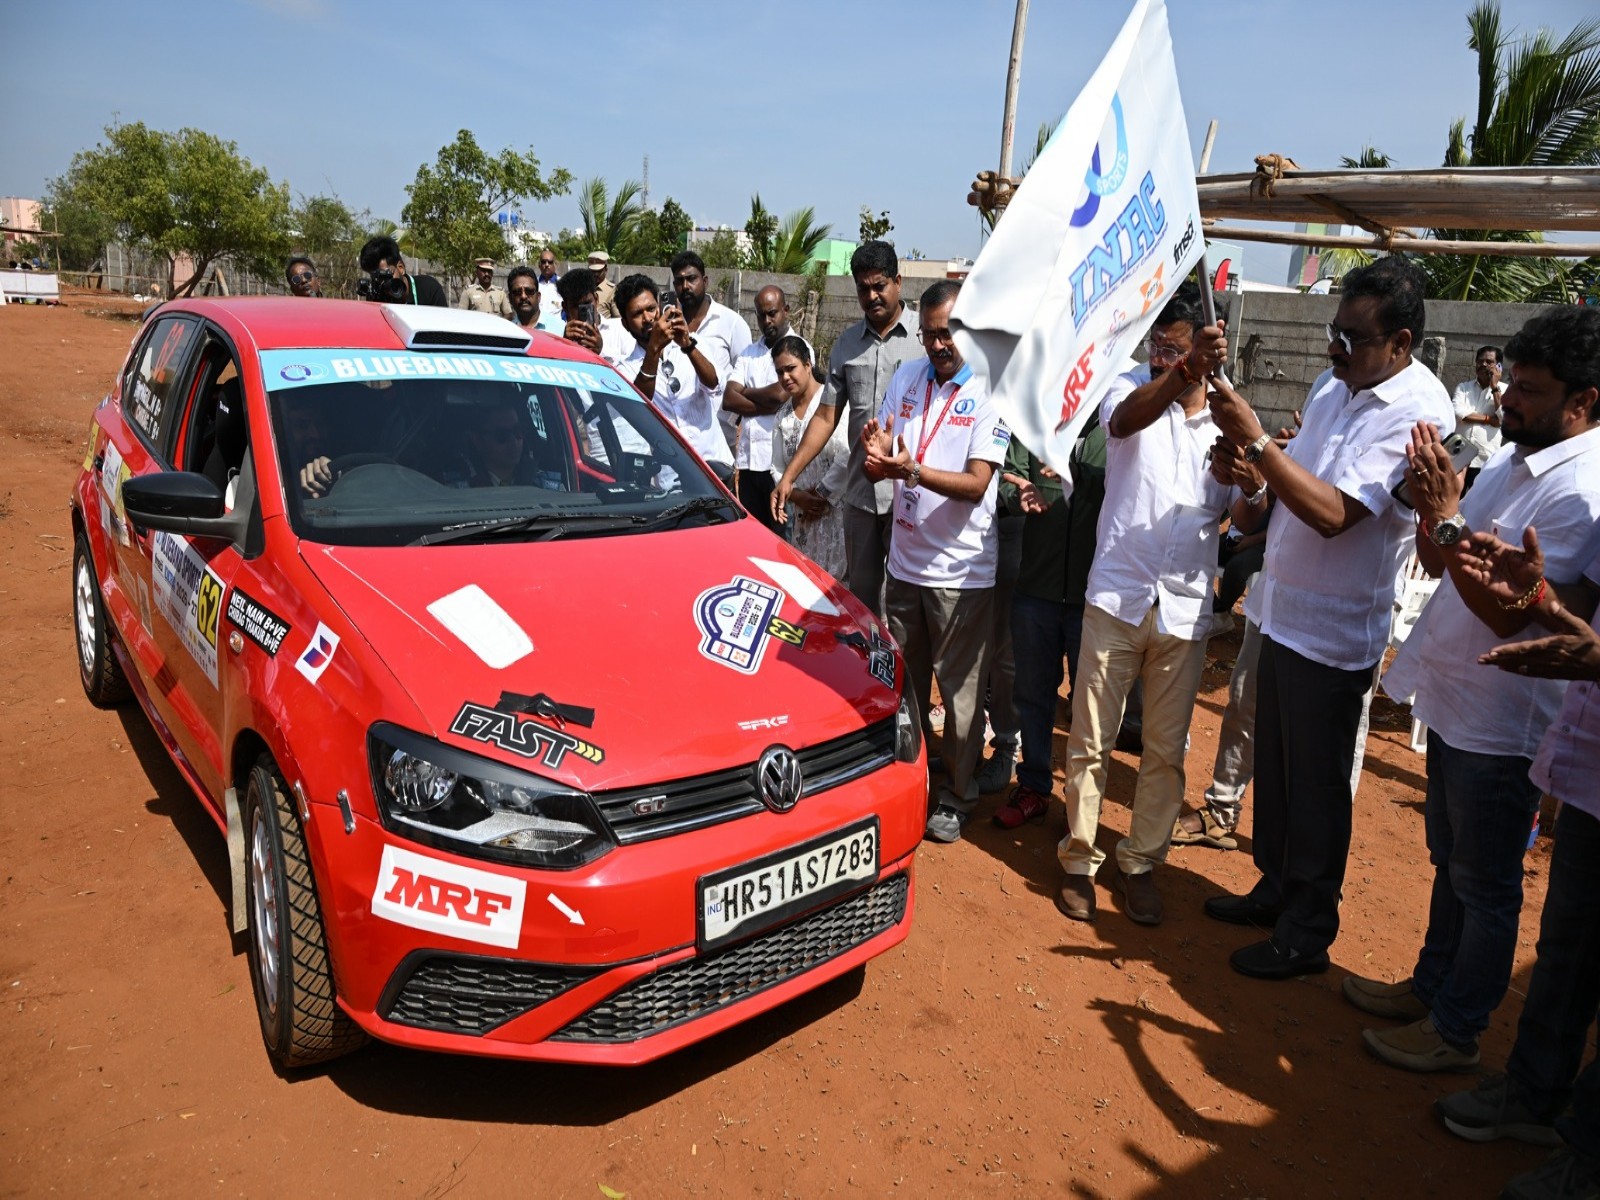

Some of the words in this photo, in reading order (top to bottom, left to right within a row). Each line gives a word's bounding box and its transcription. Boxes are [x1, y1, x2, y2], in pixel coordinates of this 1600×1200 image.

[1096, 151, 1128, 195] SPORTS
[1068, 170, 1166, 329] INRC
[331, 356, 497, 379] BLUEBAND
[499, 361, 601, 390] SPORTS
[1055, 342, 1095, 434] MRF
[947, 416, 975, 427] MRF
[198, 573, 220, 648] 62
[228, 605, 246, 627] CHIRAG
[245, 617, 266, 643] THAKUR
[263, 632, 280, 653] B+VE
[231, 591, 246, 613] NEIL
[263, 616, 287, 641] B+VE
[769, 618, 805, 643] 62
[451, 703, 578, 768] FAST
[634, 795, 666, 816] GT
[384, 866, 512, 926] MRF
[707, 902, 722, 915] IND
[721, 833, 874, 922] HR51AS7283
